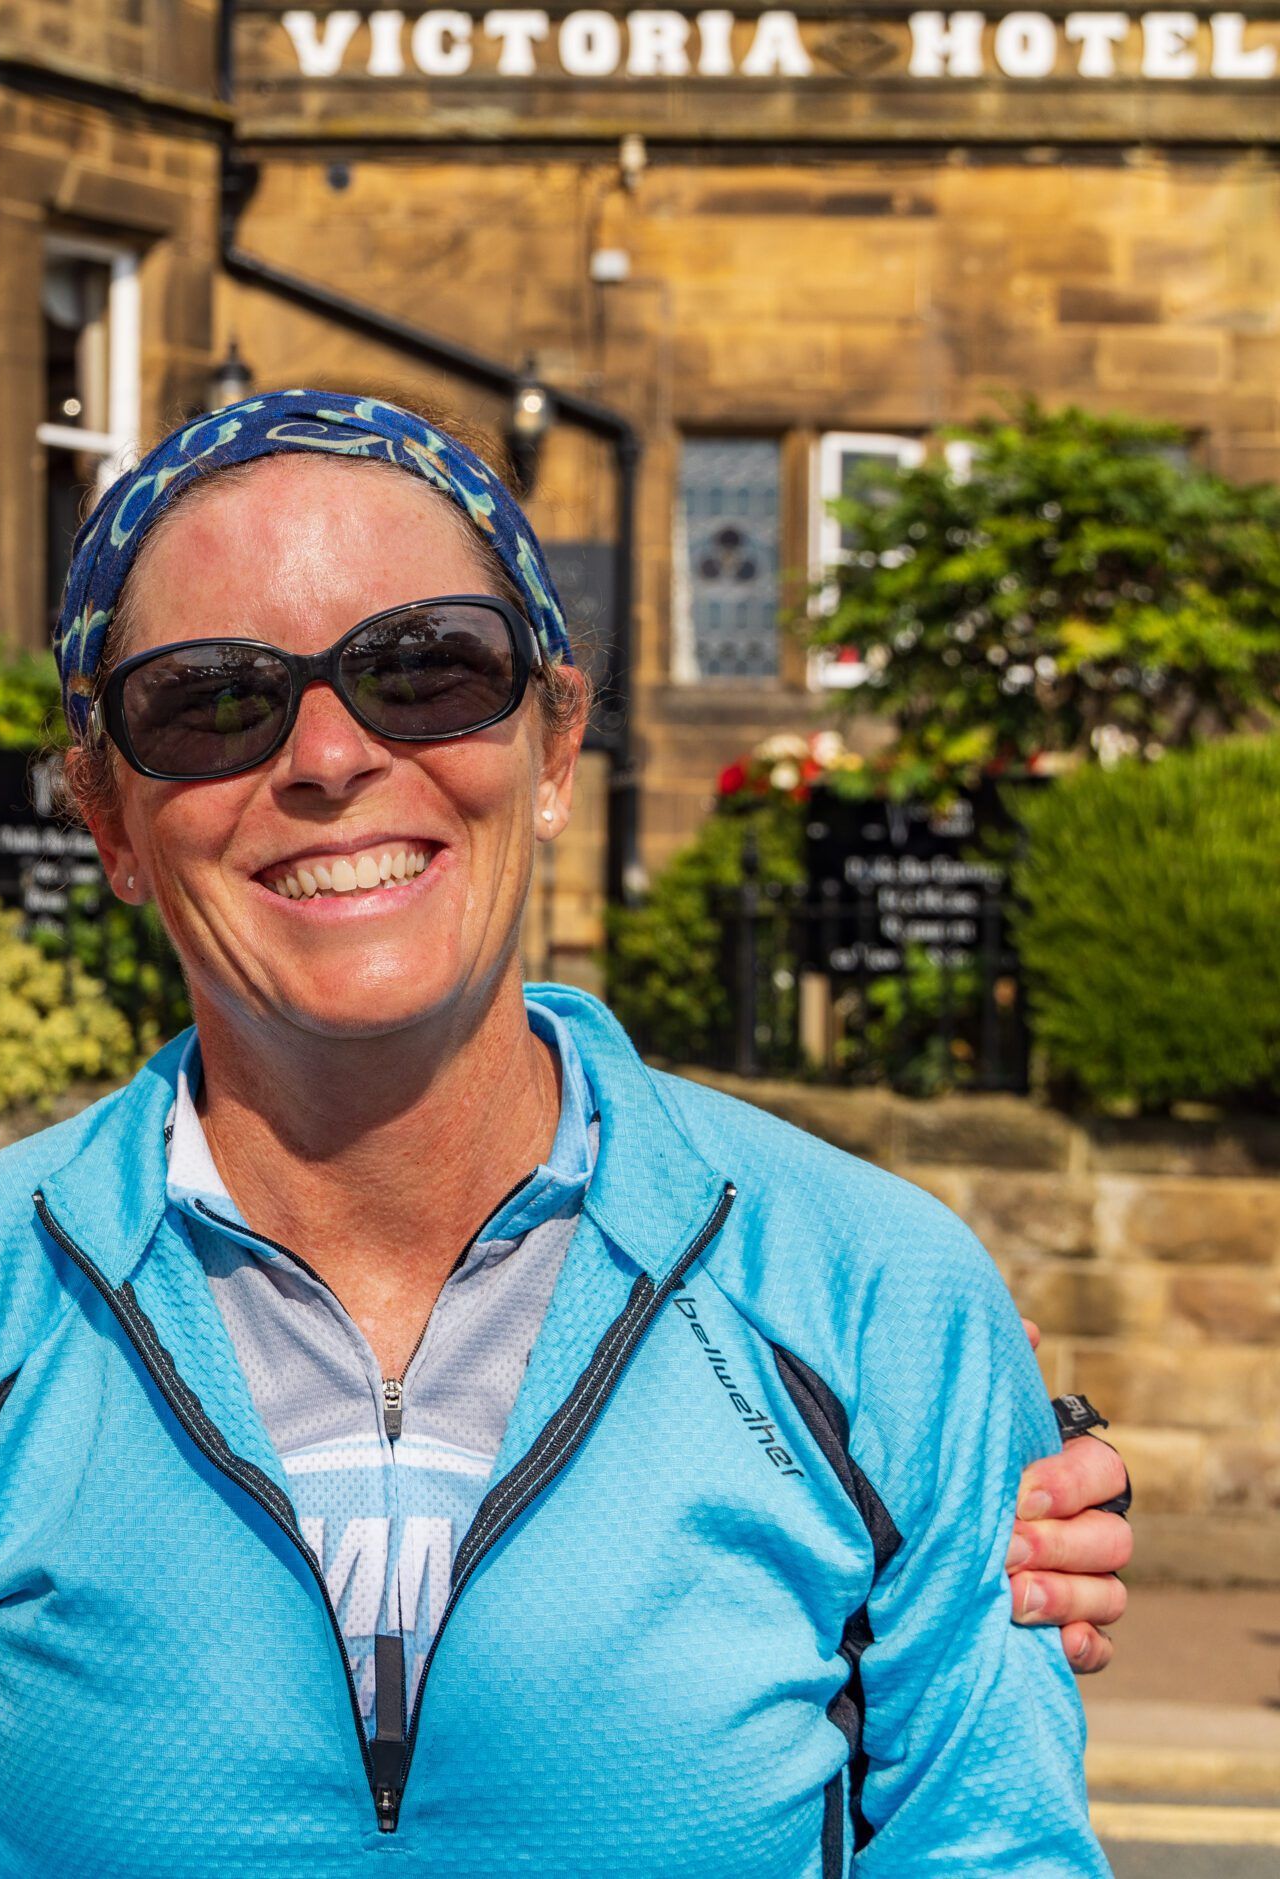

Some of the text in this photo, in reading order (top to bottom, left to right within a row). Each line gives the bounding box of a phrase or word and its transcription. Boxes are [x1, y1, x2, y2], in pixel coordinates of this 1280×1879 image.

[282, 11, 1278, 79] VICTORIA HOTEL
[673, 1297, 805, 1478] bellwether
